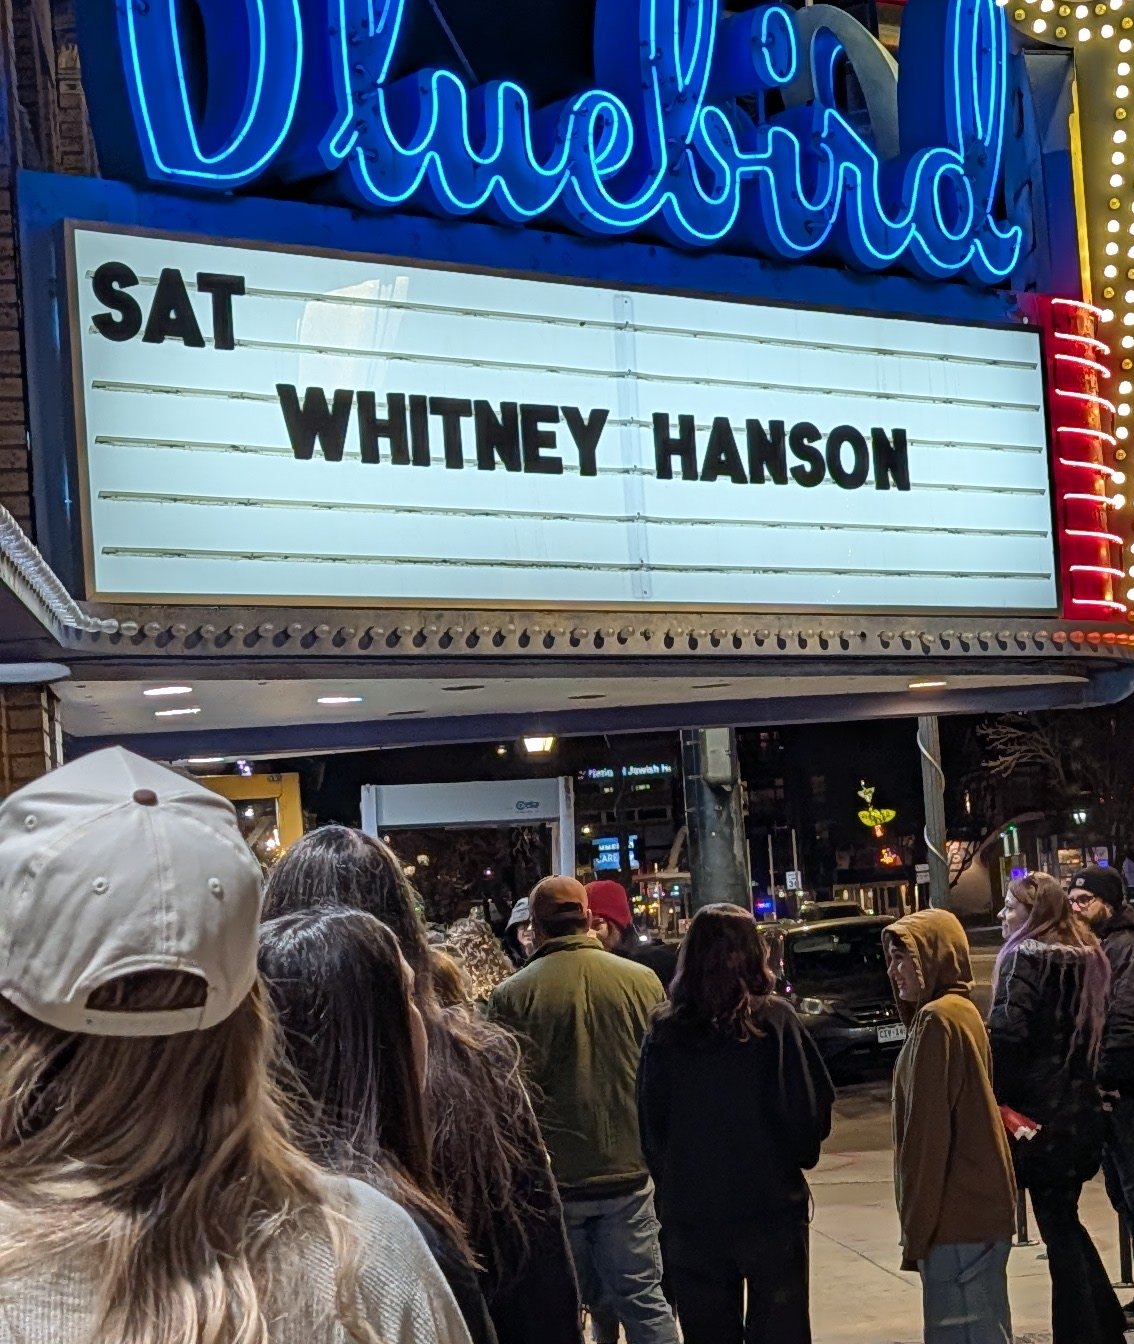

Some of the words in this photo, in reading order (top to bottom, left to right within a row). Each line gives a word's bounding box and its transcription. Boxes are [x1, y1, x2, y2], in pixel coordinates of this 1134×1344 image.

[91, 261, 246, 351] SAT
[277, 383, 608, 477] WHITNEY
[652, 412, 911, 491] HANSON
